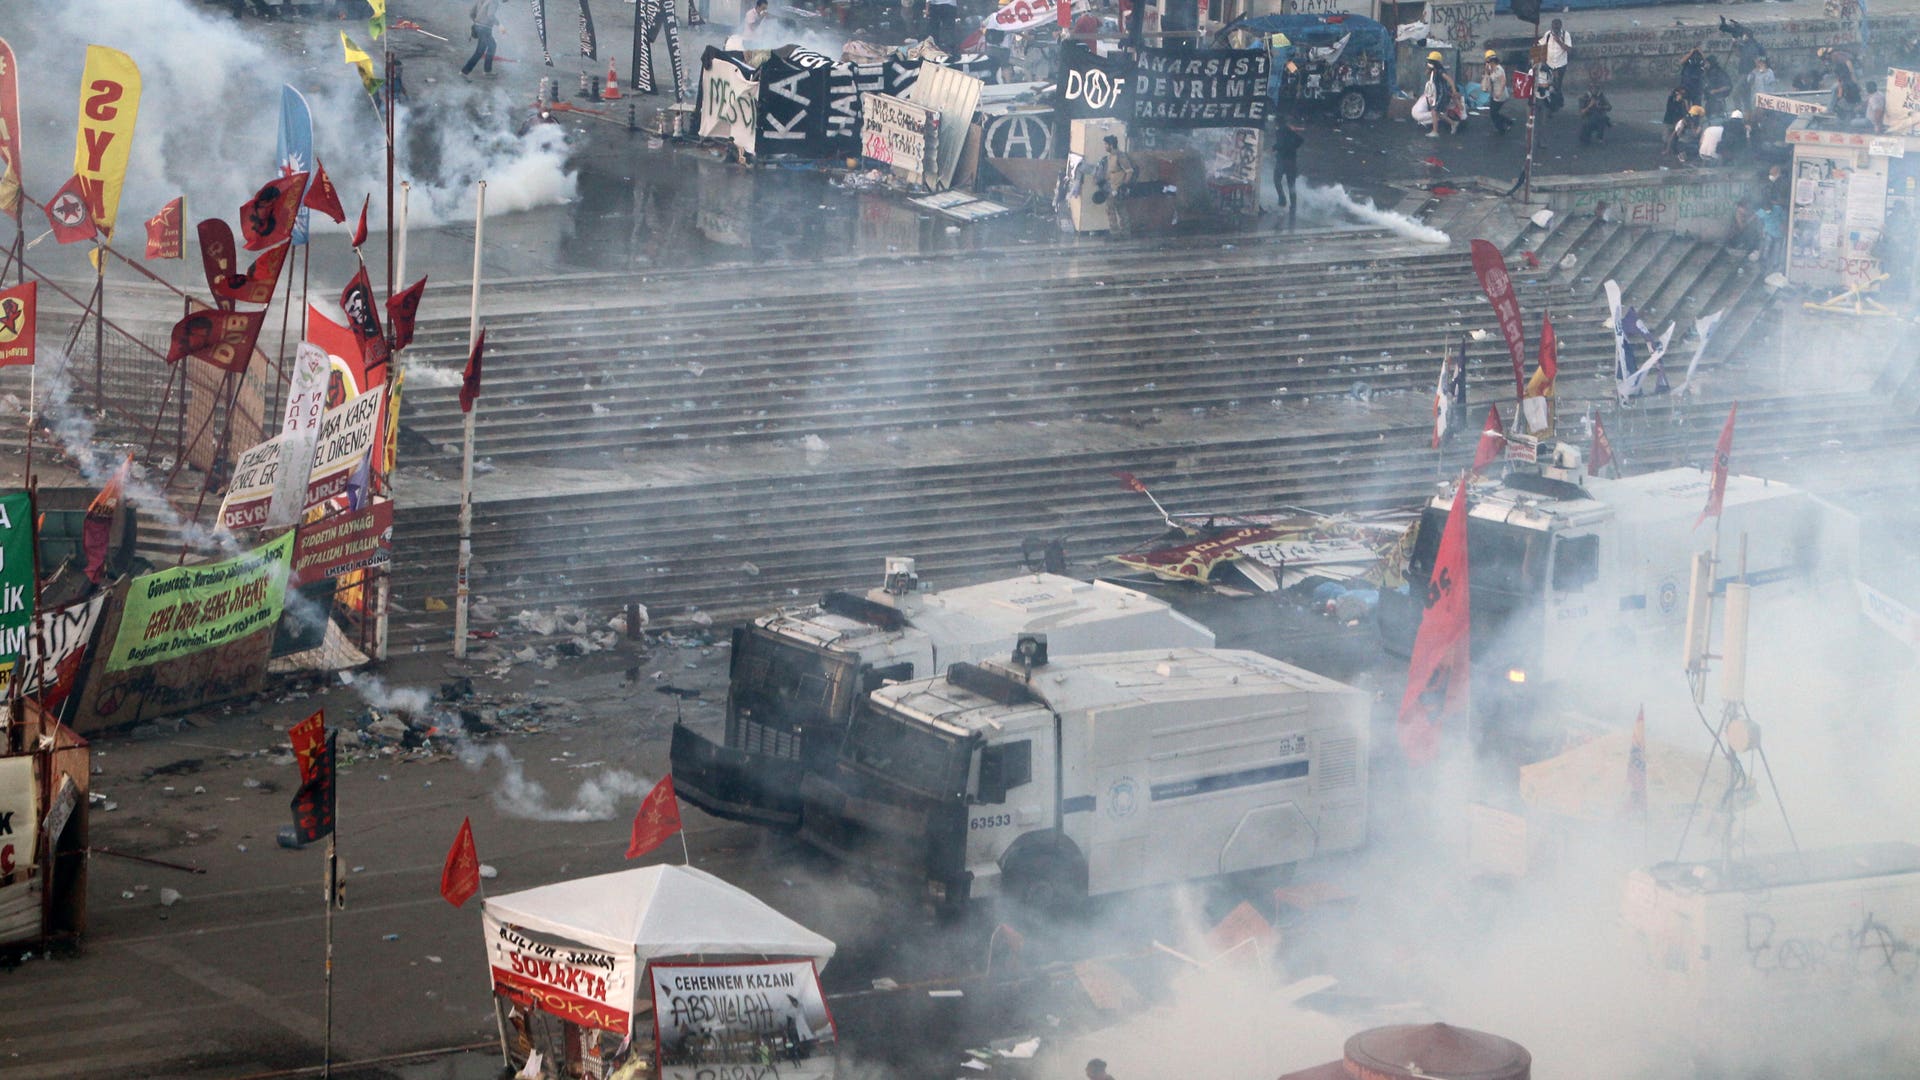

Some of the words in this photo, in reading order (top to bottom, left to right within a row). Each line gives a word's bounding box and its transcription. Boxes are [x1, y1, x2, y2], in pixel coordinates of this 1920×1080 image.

[970, 813, 1011, 830] 63533
[674, 975, 743, 992] CEHENNEM
[744, 972, 795, 990] KAZANI
